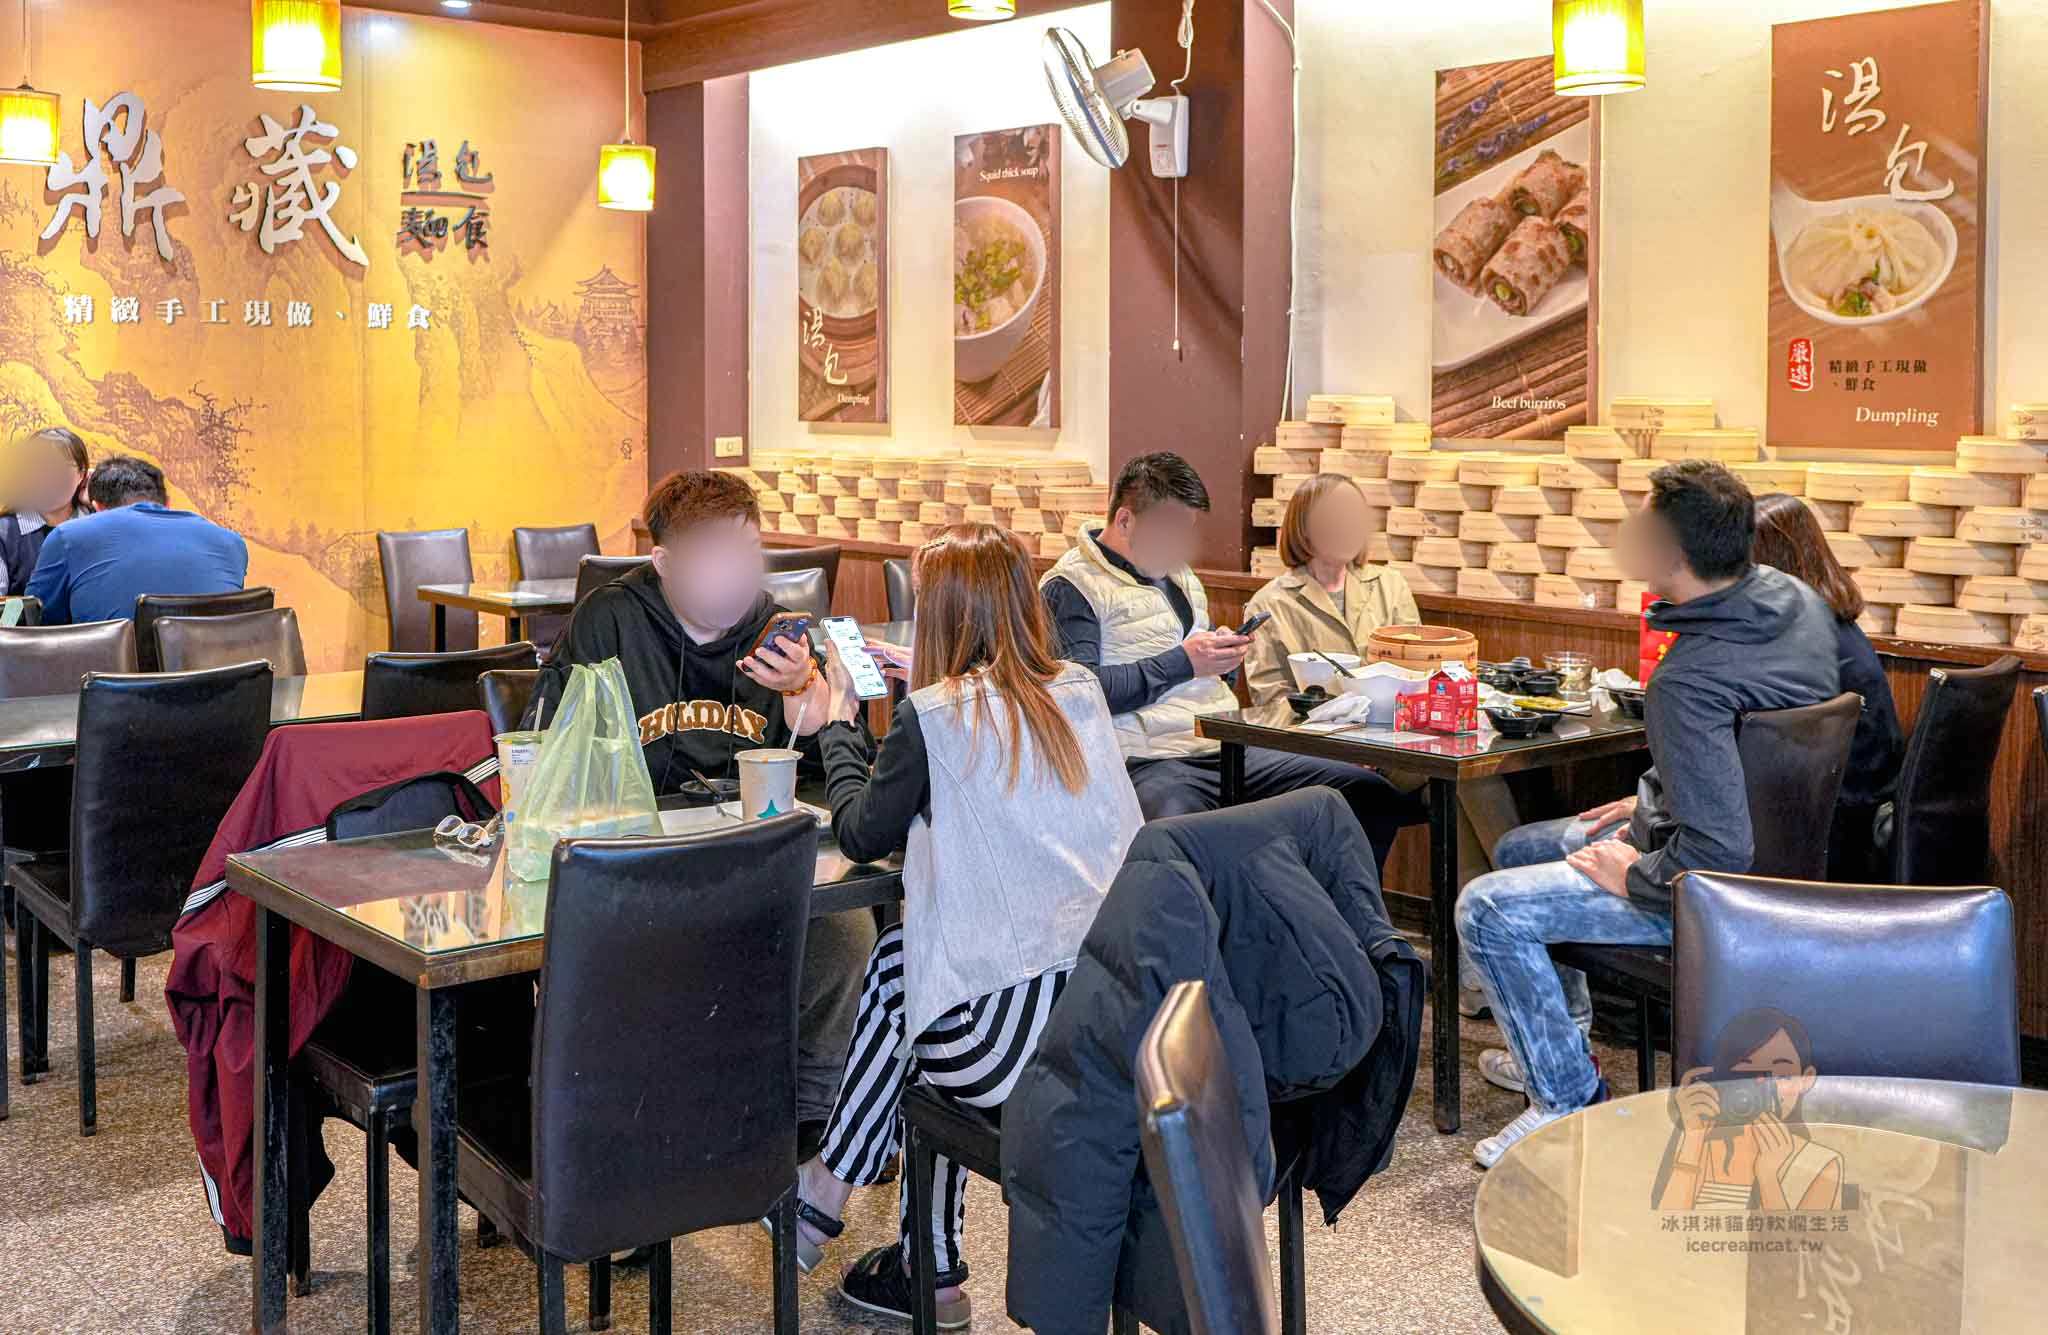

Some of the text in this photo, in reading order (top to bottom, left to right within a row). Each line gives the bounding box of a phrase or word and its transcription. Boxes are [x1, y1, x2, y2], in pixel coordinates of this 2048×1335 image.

[1820, 56, 1956, 204] 湯包
[1519, 395, 1568, 410] burritos
[1855, 405, 1940, 427] Dumpling
[638, 699, 768, 747] HOLIDAY
